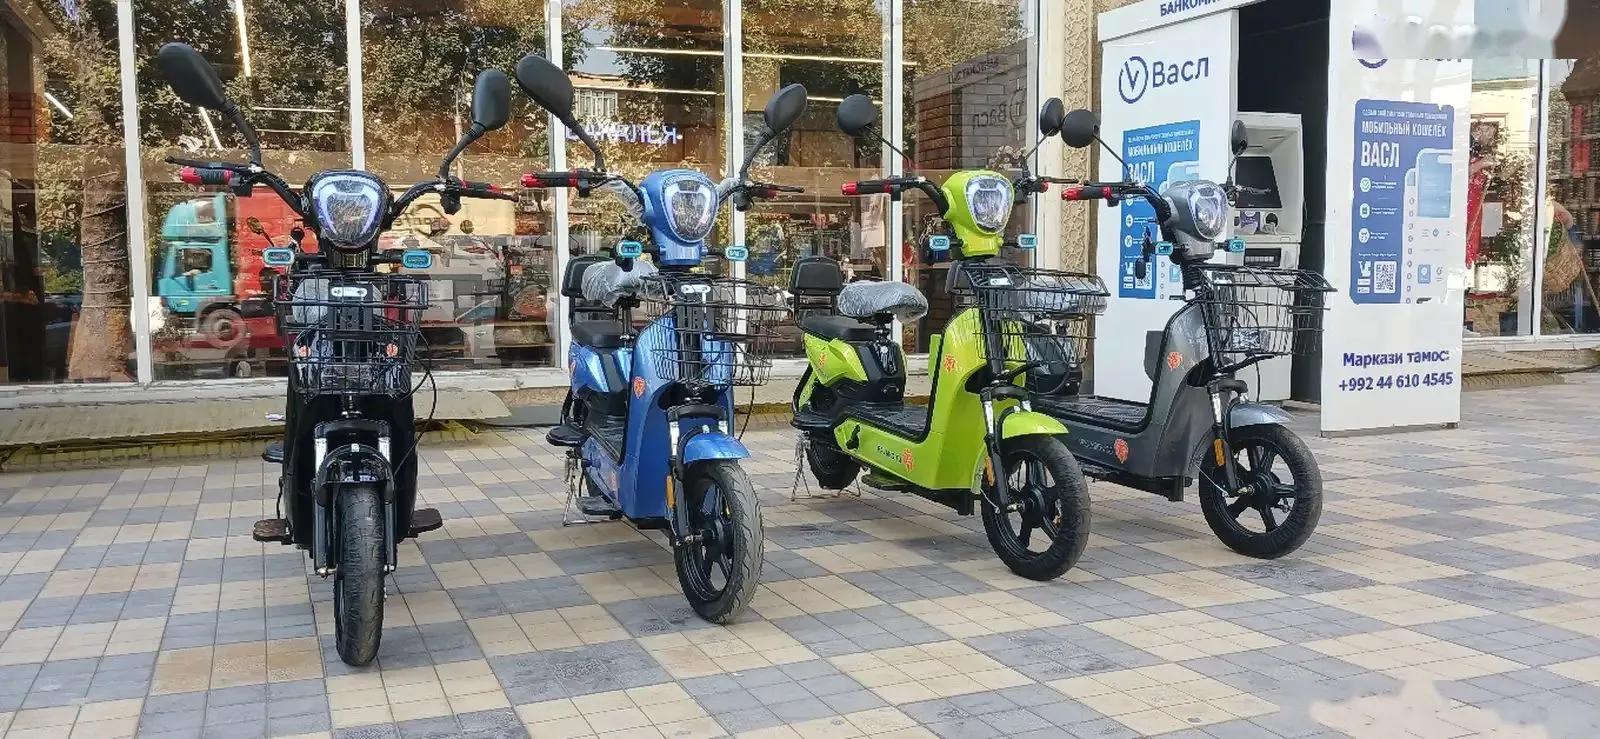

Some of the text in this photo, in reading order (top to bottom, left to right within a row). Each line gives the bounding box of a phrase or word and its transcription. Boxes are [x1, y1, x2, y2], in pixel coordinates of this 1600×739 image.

[1160, 0, 1220, 17] БАНКОМ
[1153, 57, 1209, 88] Васл
[1361, 120, 1447, 137] МОБИЛЬНЫЙ КОШЕЛЁК
[1361, 141, 1400, 168] ВАСЛ
[1343, 350, 1450, 368] Маркази тамос:
[1339, 371, 1454, 391] +992 44 610 4545
